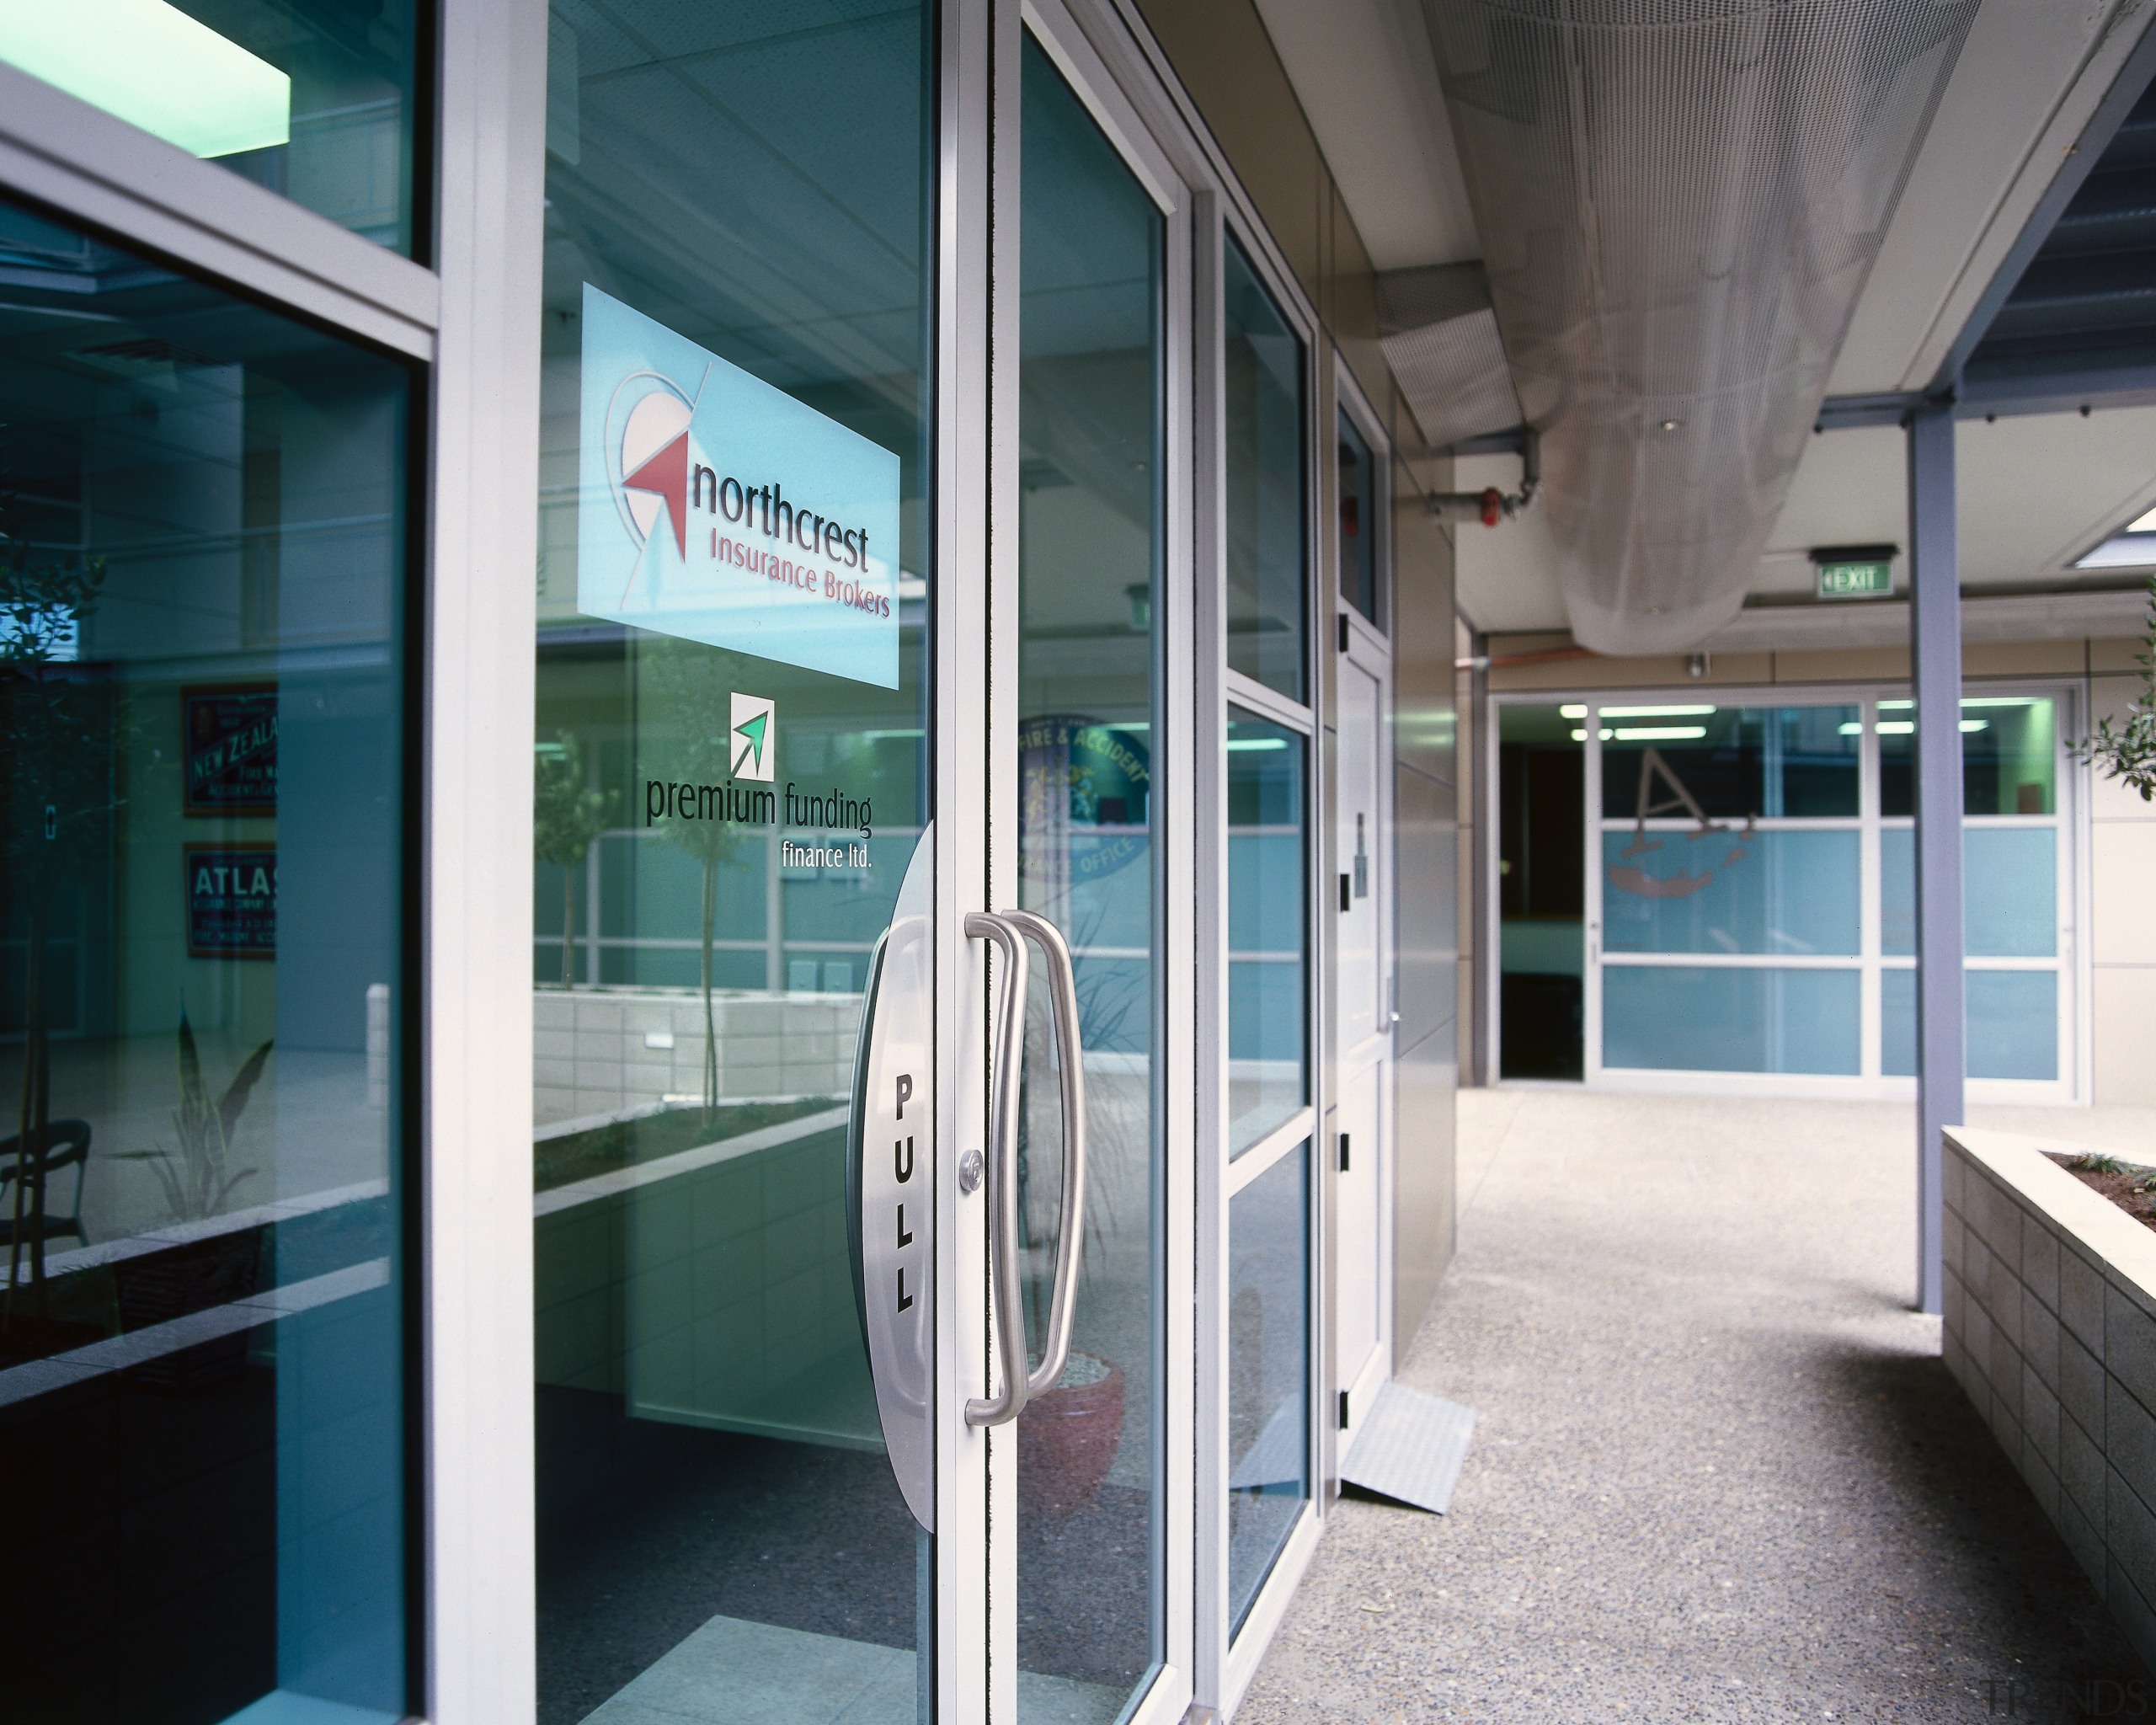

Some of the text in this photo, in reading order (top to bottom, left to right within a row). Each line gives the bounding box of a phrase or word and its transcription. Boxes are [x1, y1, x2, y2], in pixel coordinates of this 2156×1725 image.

[694, 462, 868, 572] northcrest
[711, 527, 890, 618] Insurance Brokers
[1833, 565, 1878, 592] EXIT
[194, 745, 222, 782] NEW
[1073, 728, 1147, 783] ACCIDENT
[646, 780, 873, 840] premium funding
[782, 840, 873, 868] finance ltd.
[1080, 836, 1135, 873] OFFICE
[894, 1073, 914, 1314] PULL
